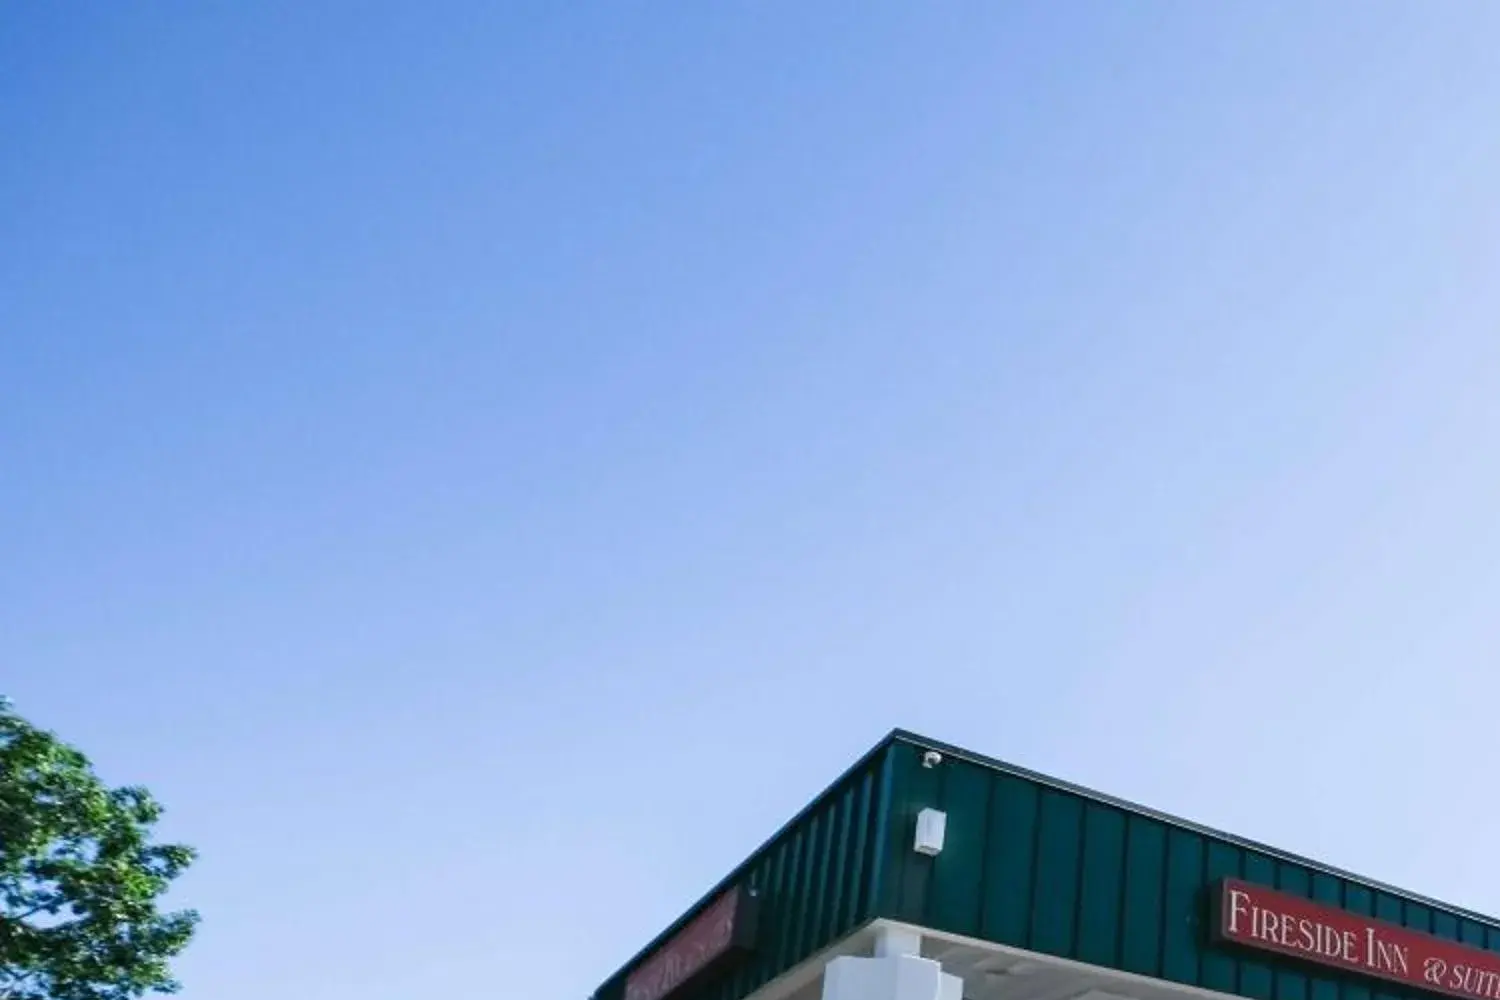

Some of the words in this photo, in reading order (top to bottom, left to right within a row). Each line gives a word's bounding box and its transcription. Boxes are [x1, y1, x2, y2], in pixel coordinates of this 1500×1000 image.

[1228, 889, 1359, 962] FIRESIDE
[1365, 927, 1408, 976] INN
[1423, 957, 1447, 985] &
